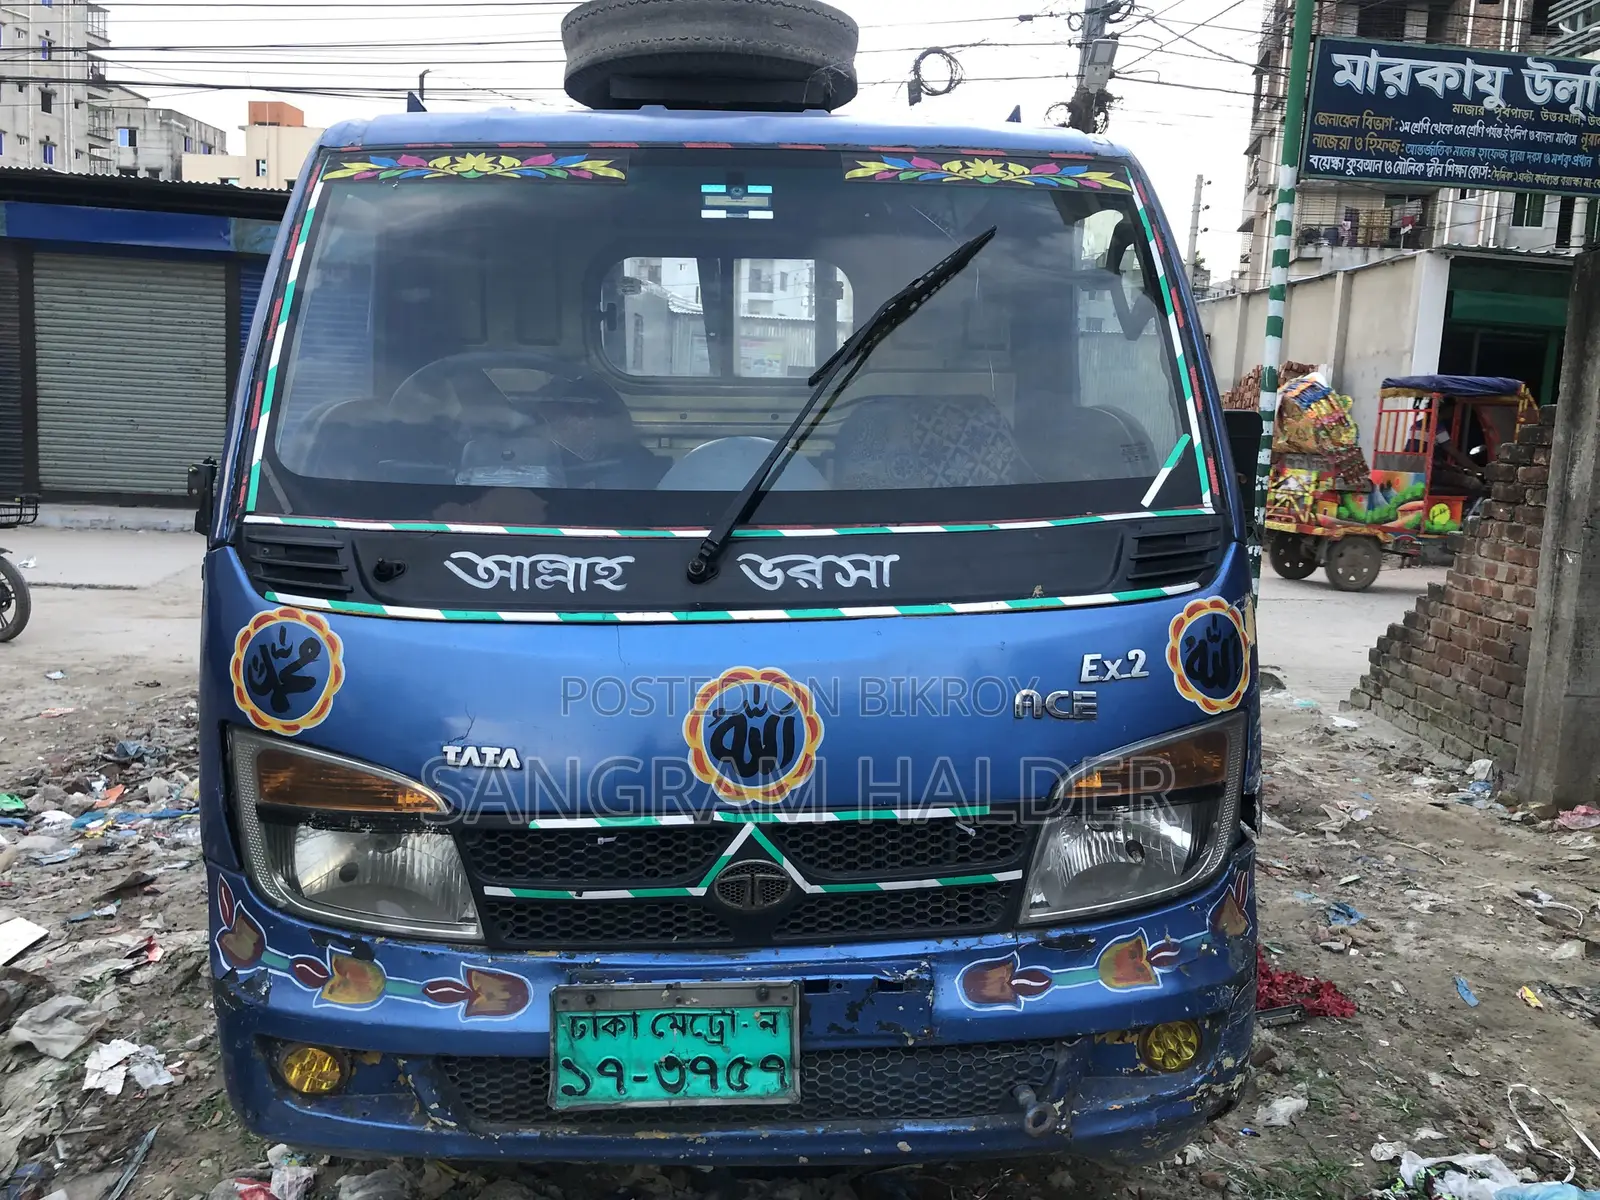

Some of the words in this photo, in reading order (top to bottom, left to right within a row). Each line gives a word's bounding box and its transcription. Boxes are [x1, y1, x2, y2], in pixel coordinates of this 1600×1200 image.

[1330, 48, 1513, 110] মারকাযু
[1452, 103, 1485, 116] মাজার
[1312, 133, 1353, 151] নাজেরা
[1354, 136, 1363, 151] ও
[1345, 157, 1384, 176] কুরআন
[1384, 160, 1393, 174] ও
[1444, 158, 1468, 178] শিক্ষা
[444, 551, 635, 593] আল্লাহ
[736, 552, 900, 591] ভরসা
[1013, 688, 1097, 720] ACE
[442, 745, 520, 770] TATA
[568, 1009, 641, 1039] ঢাকা
[560, 1053, 791, 1097] ১৭-৩৭৫৭
